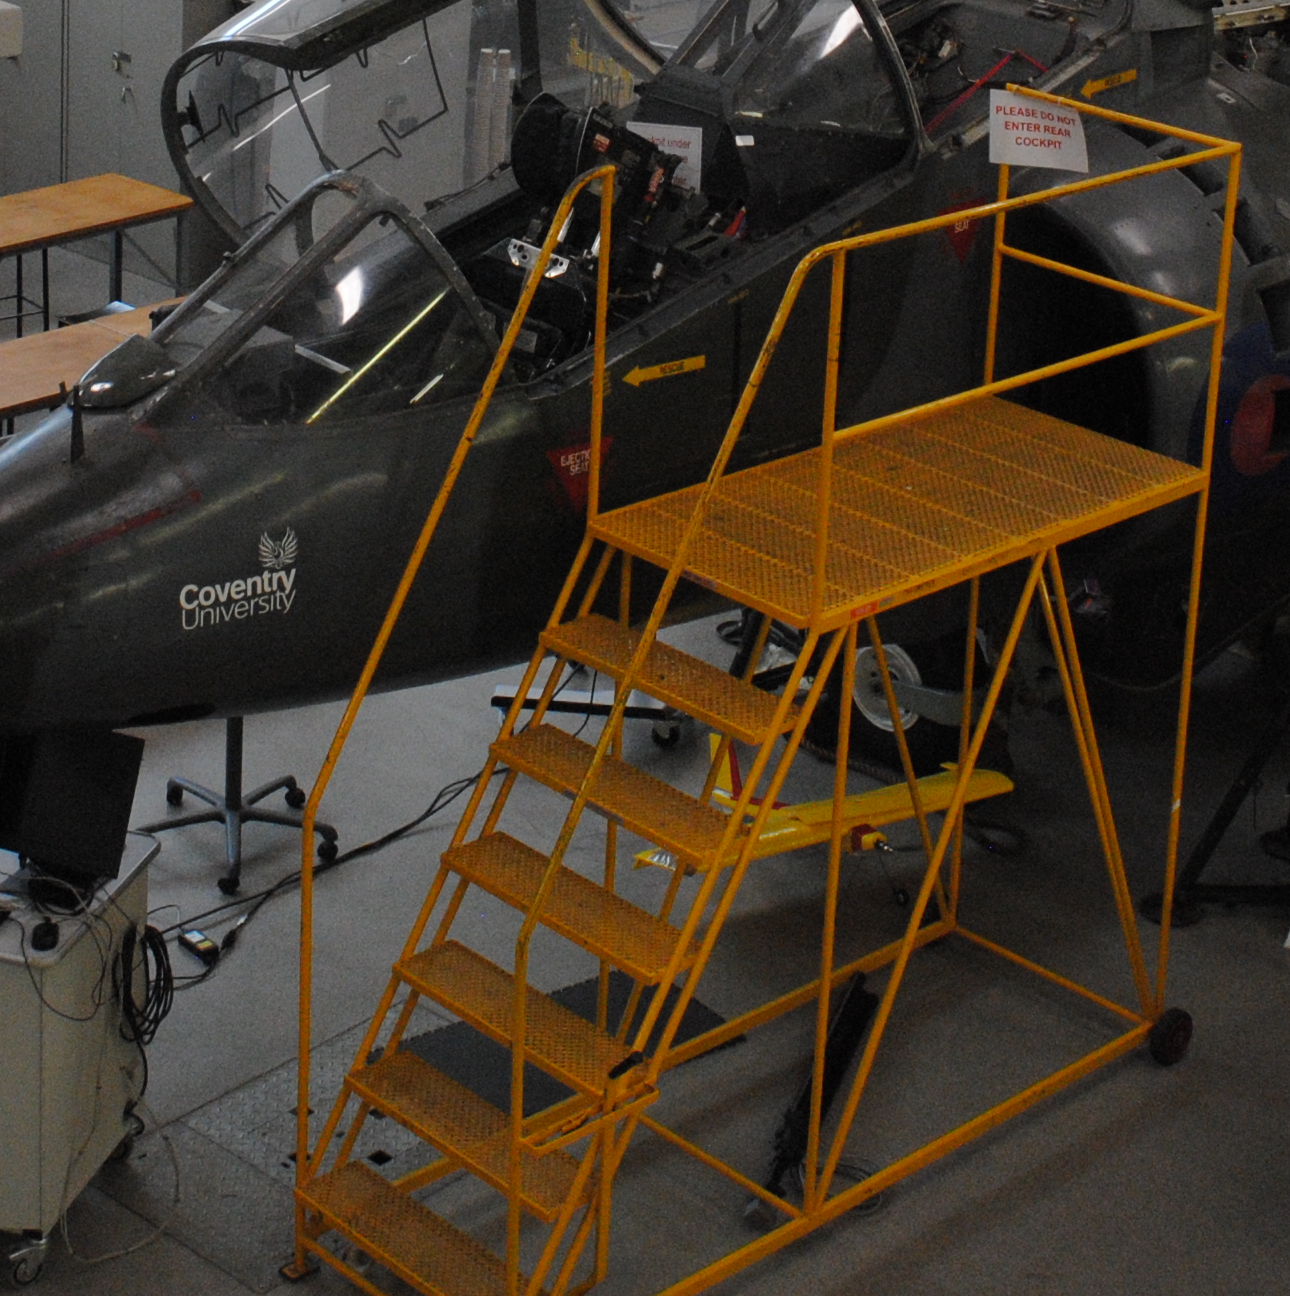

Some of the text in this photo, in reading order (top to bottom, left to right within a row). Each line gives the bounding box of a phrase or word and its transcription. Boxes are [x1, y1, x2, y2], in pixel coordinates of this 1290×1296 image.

[995, 105, 1076, 126] PLEASE DO NOT
[1004, 121, 1072, 138] ENTER REAR
[667, 138, 692, 149] under
[1015, 136, 1063, 150] COCKPIT
[560, 449, 591, 467] EJECTI
[570, 461, 590, 475] SEAT
[179, 568, 297, 610] Coventry
[182, 589, 297, 631] University
